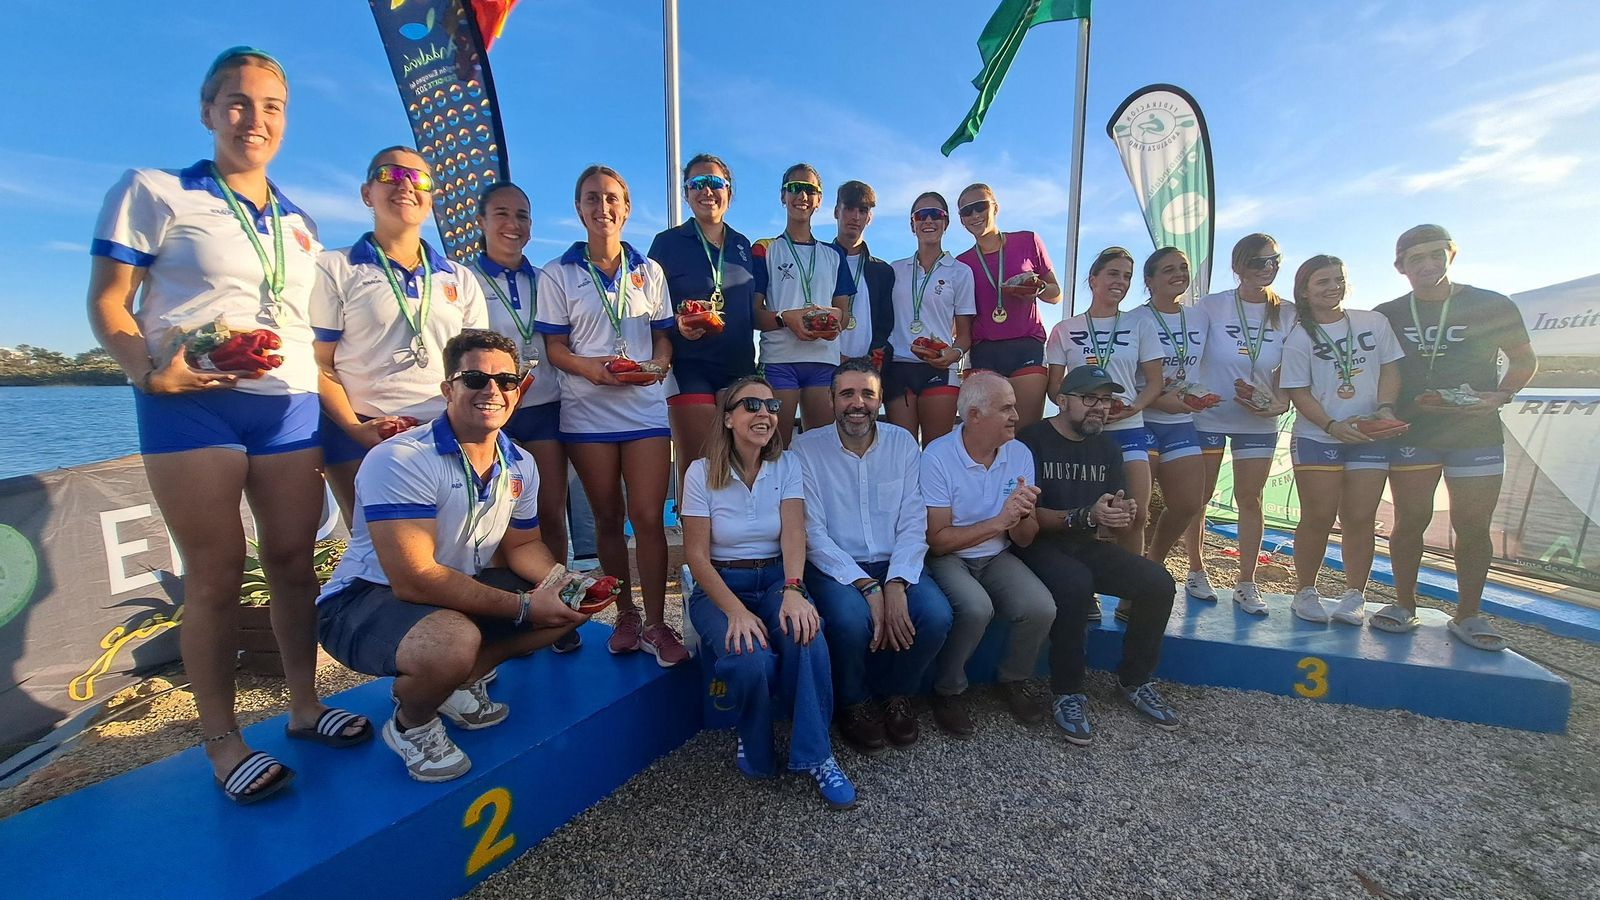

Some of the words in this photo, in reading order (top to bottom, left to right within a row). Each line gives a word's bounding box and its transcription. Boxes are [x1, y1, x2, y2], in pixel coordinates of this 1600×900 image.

[1069, 330, 1132, 346] RCC
[1043, 462, 1106, 482] MUSTANG
[1293, 656, 1329, 698] 3
[463, 787, 516, 877] 2
